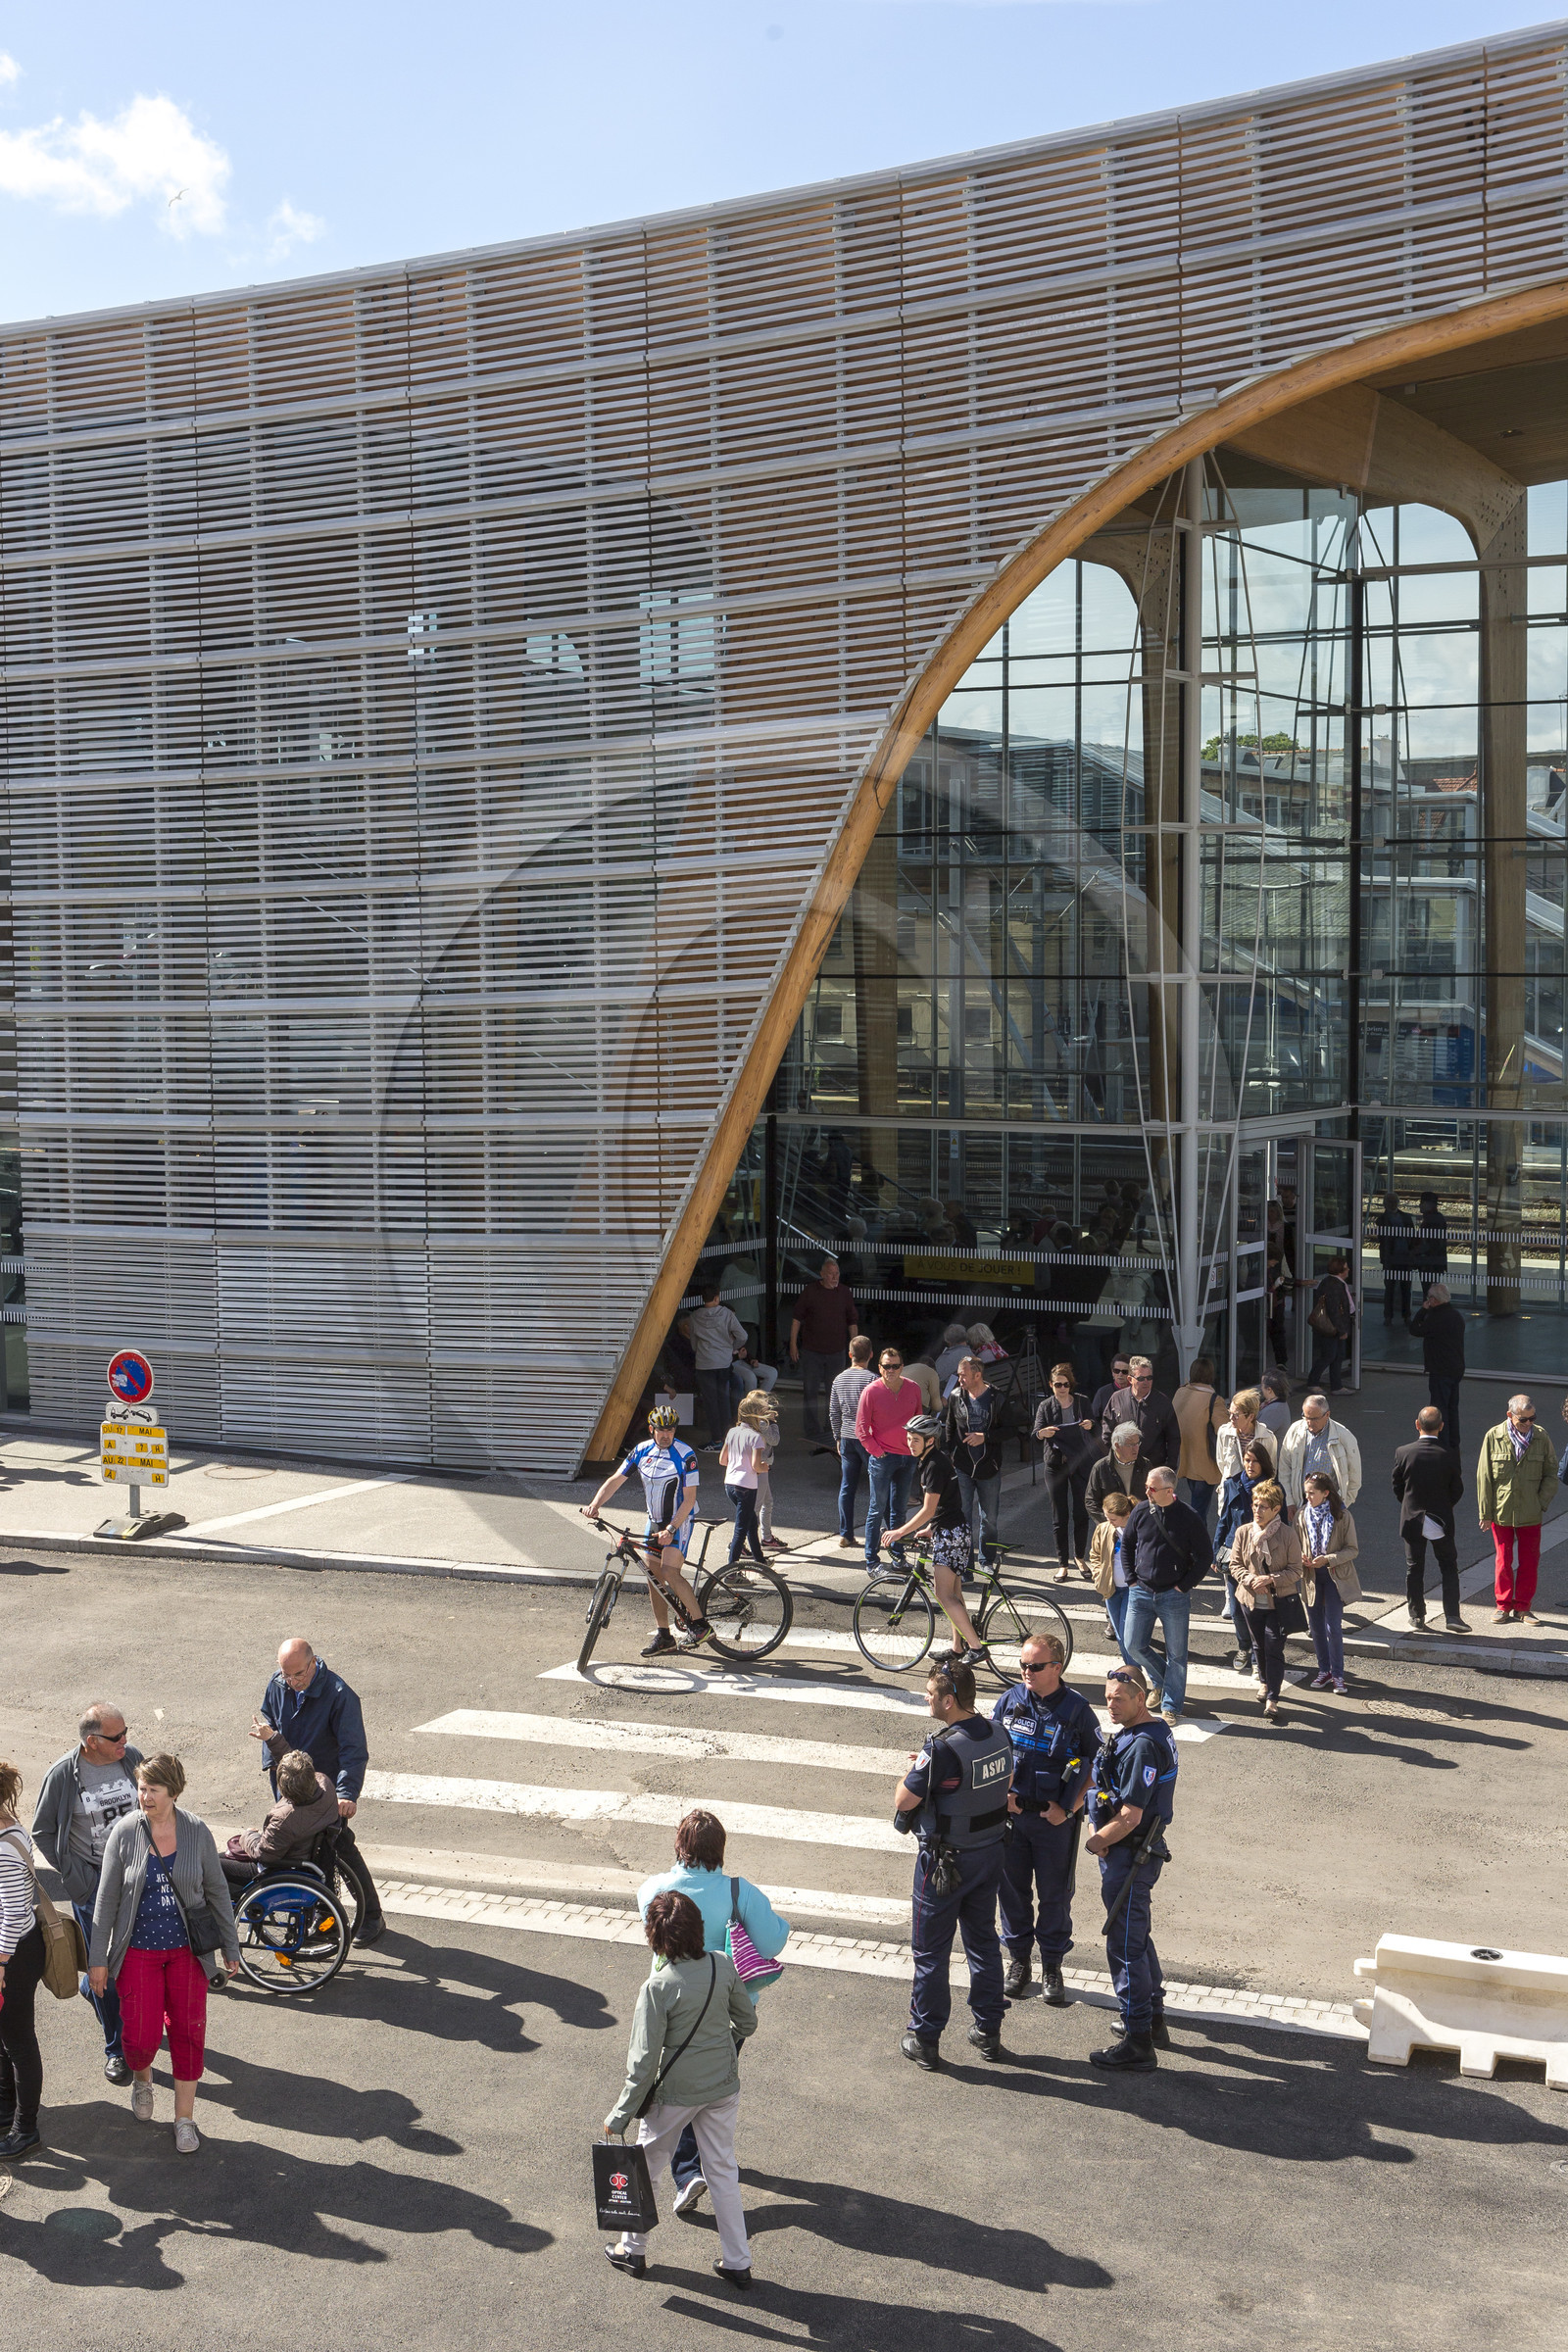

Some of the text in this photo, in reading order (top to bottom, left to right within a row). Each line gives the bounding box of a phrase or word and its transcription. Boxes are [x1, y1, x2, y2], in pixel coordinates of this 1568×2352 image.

[927, 1260, 956, 1271] VOUS
[959, 1262, 975, 1272] DE
[978, 1262, 1014, 1275] JOUER
[1014, 1718, 1034, 1728] POLICE
[982, 1757, 1006, 1779] ASVP
[99, 1792, 132, 1806] BROOKLYN
[161, 1895, 175, 1907] DAY
